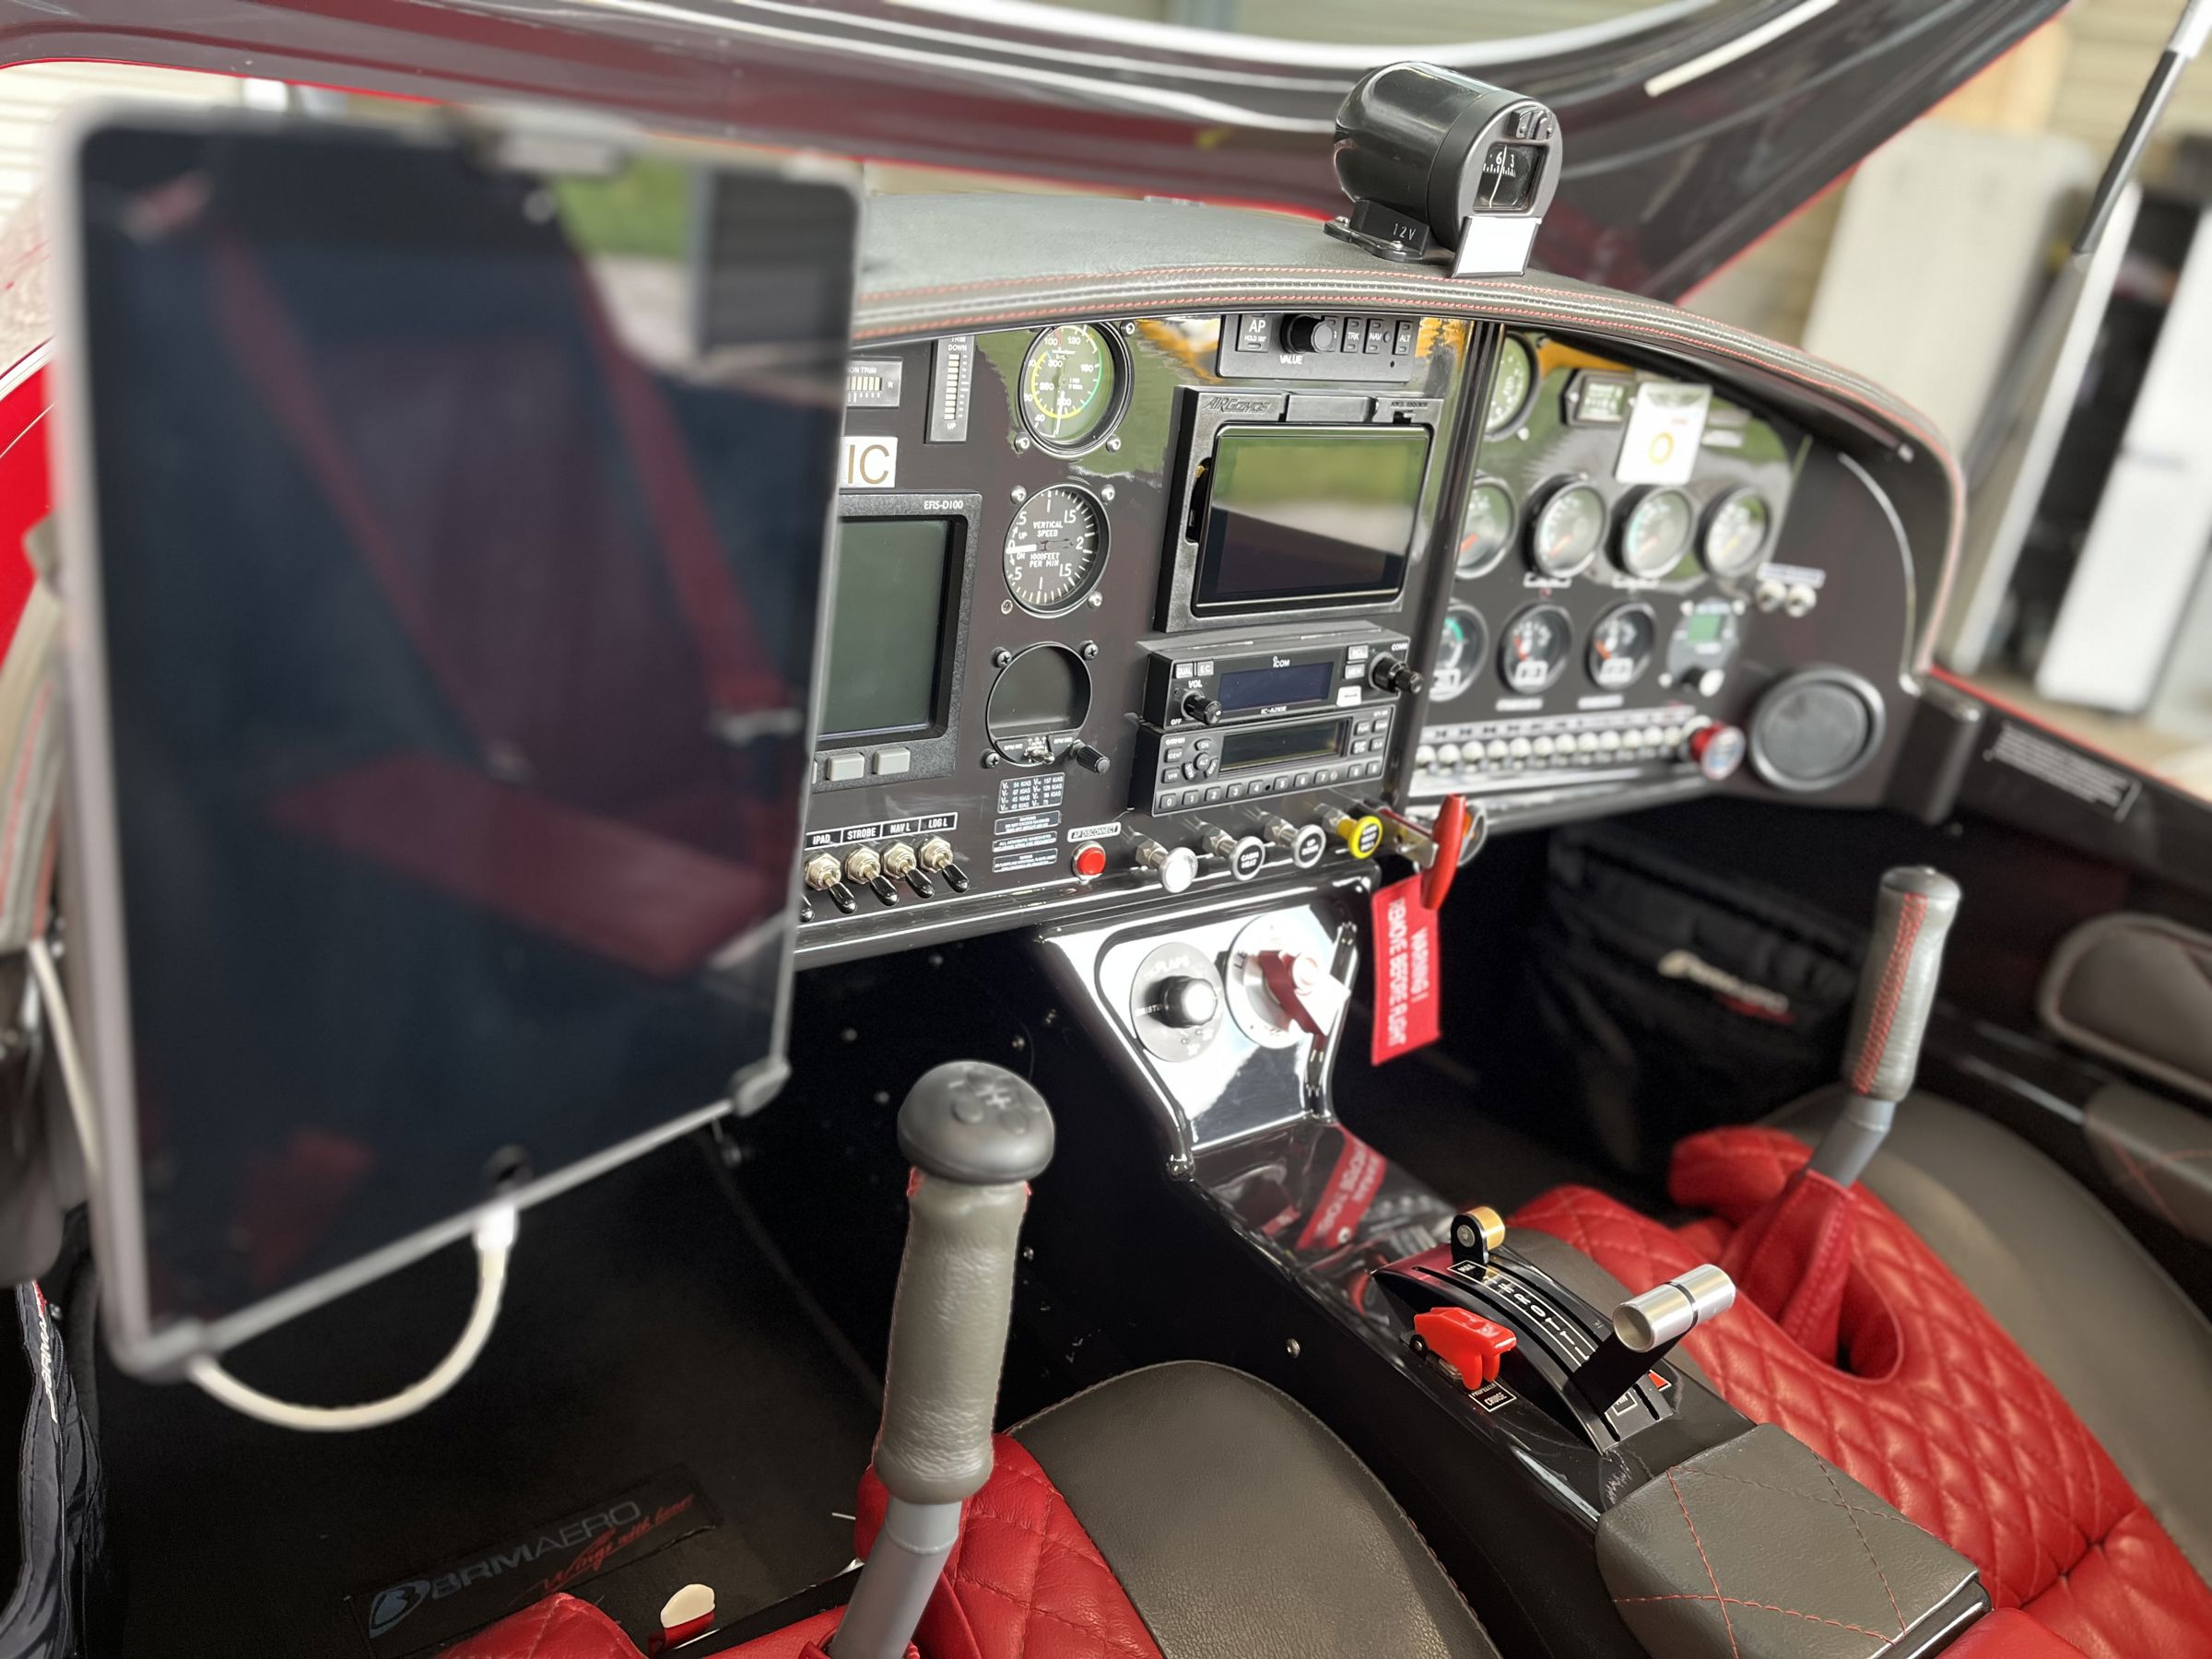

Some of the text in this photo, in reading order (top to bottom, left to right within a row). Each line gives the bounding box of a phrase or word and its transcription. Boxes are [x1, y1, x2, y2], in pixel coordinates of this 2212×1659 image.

[1495, 151, 1515, 168] 6 3
[1249, 319, 1266, 333] AP
[1043, 337, 1059, 346] 100
[1347, 332, 1359, 340] TRK
[1369, 332, 1382, 341] NAV
[1399, 334, 1411, 342] ALT
[1279, 355, 1303, 365] VALUE
[947, 422, 957, 430] UP
[924, 500, 964, 510] EFIS-D100
[1033, 521, 1064, 529] VERTICAL
[1018, 532, 1028, 540] UP
[1037, 529, 1059, 537] SPEED
[1076, 535, 1085, 550] 2
[1188, 679, 1203, 688] VOL
[890, 823, 904, 834] NAV
[928, 818, 942, 829] LDG
[847, 828, 877, 841] STROBE
[1073, 825, 1116, 839] AP DISCONNECT
[812, 834, 831, 845] IPAD
[1241, 852, 1260, 862] CABIN
[1241, 859, 1257, 869] HEAT
[1388, 897, 1408, 1047] REMOVE BEFORE FLIGHT
[1484, 1392, 1507, 1406] CRUISE
